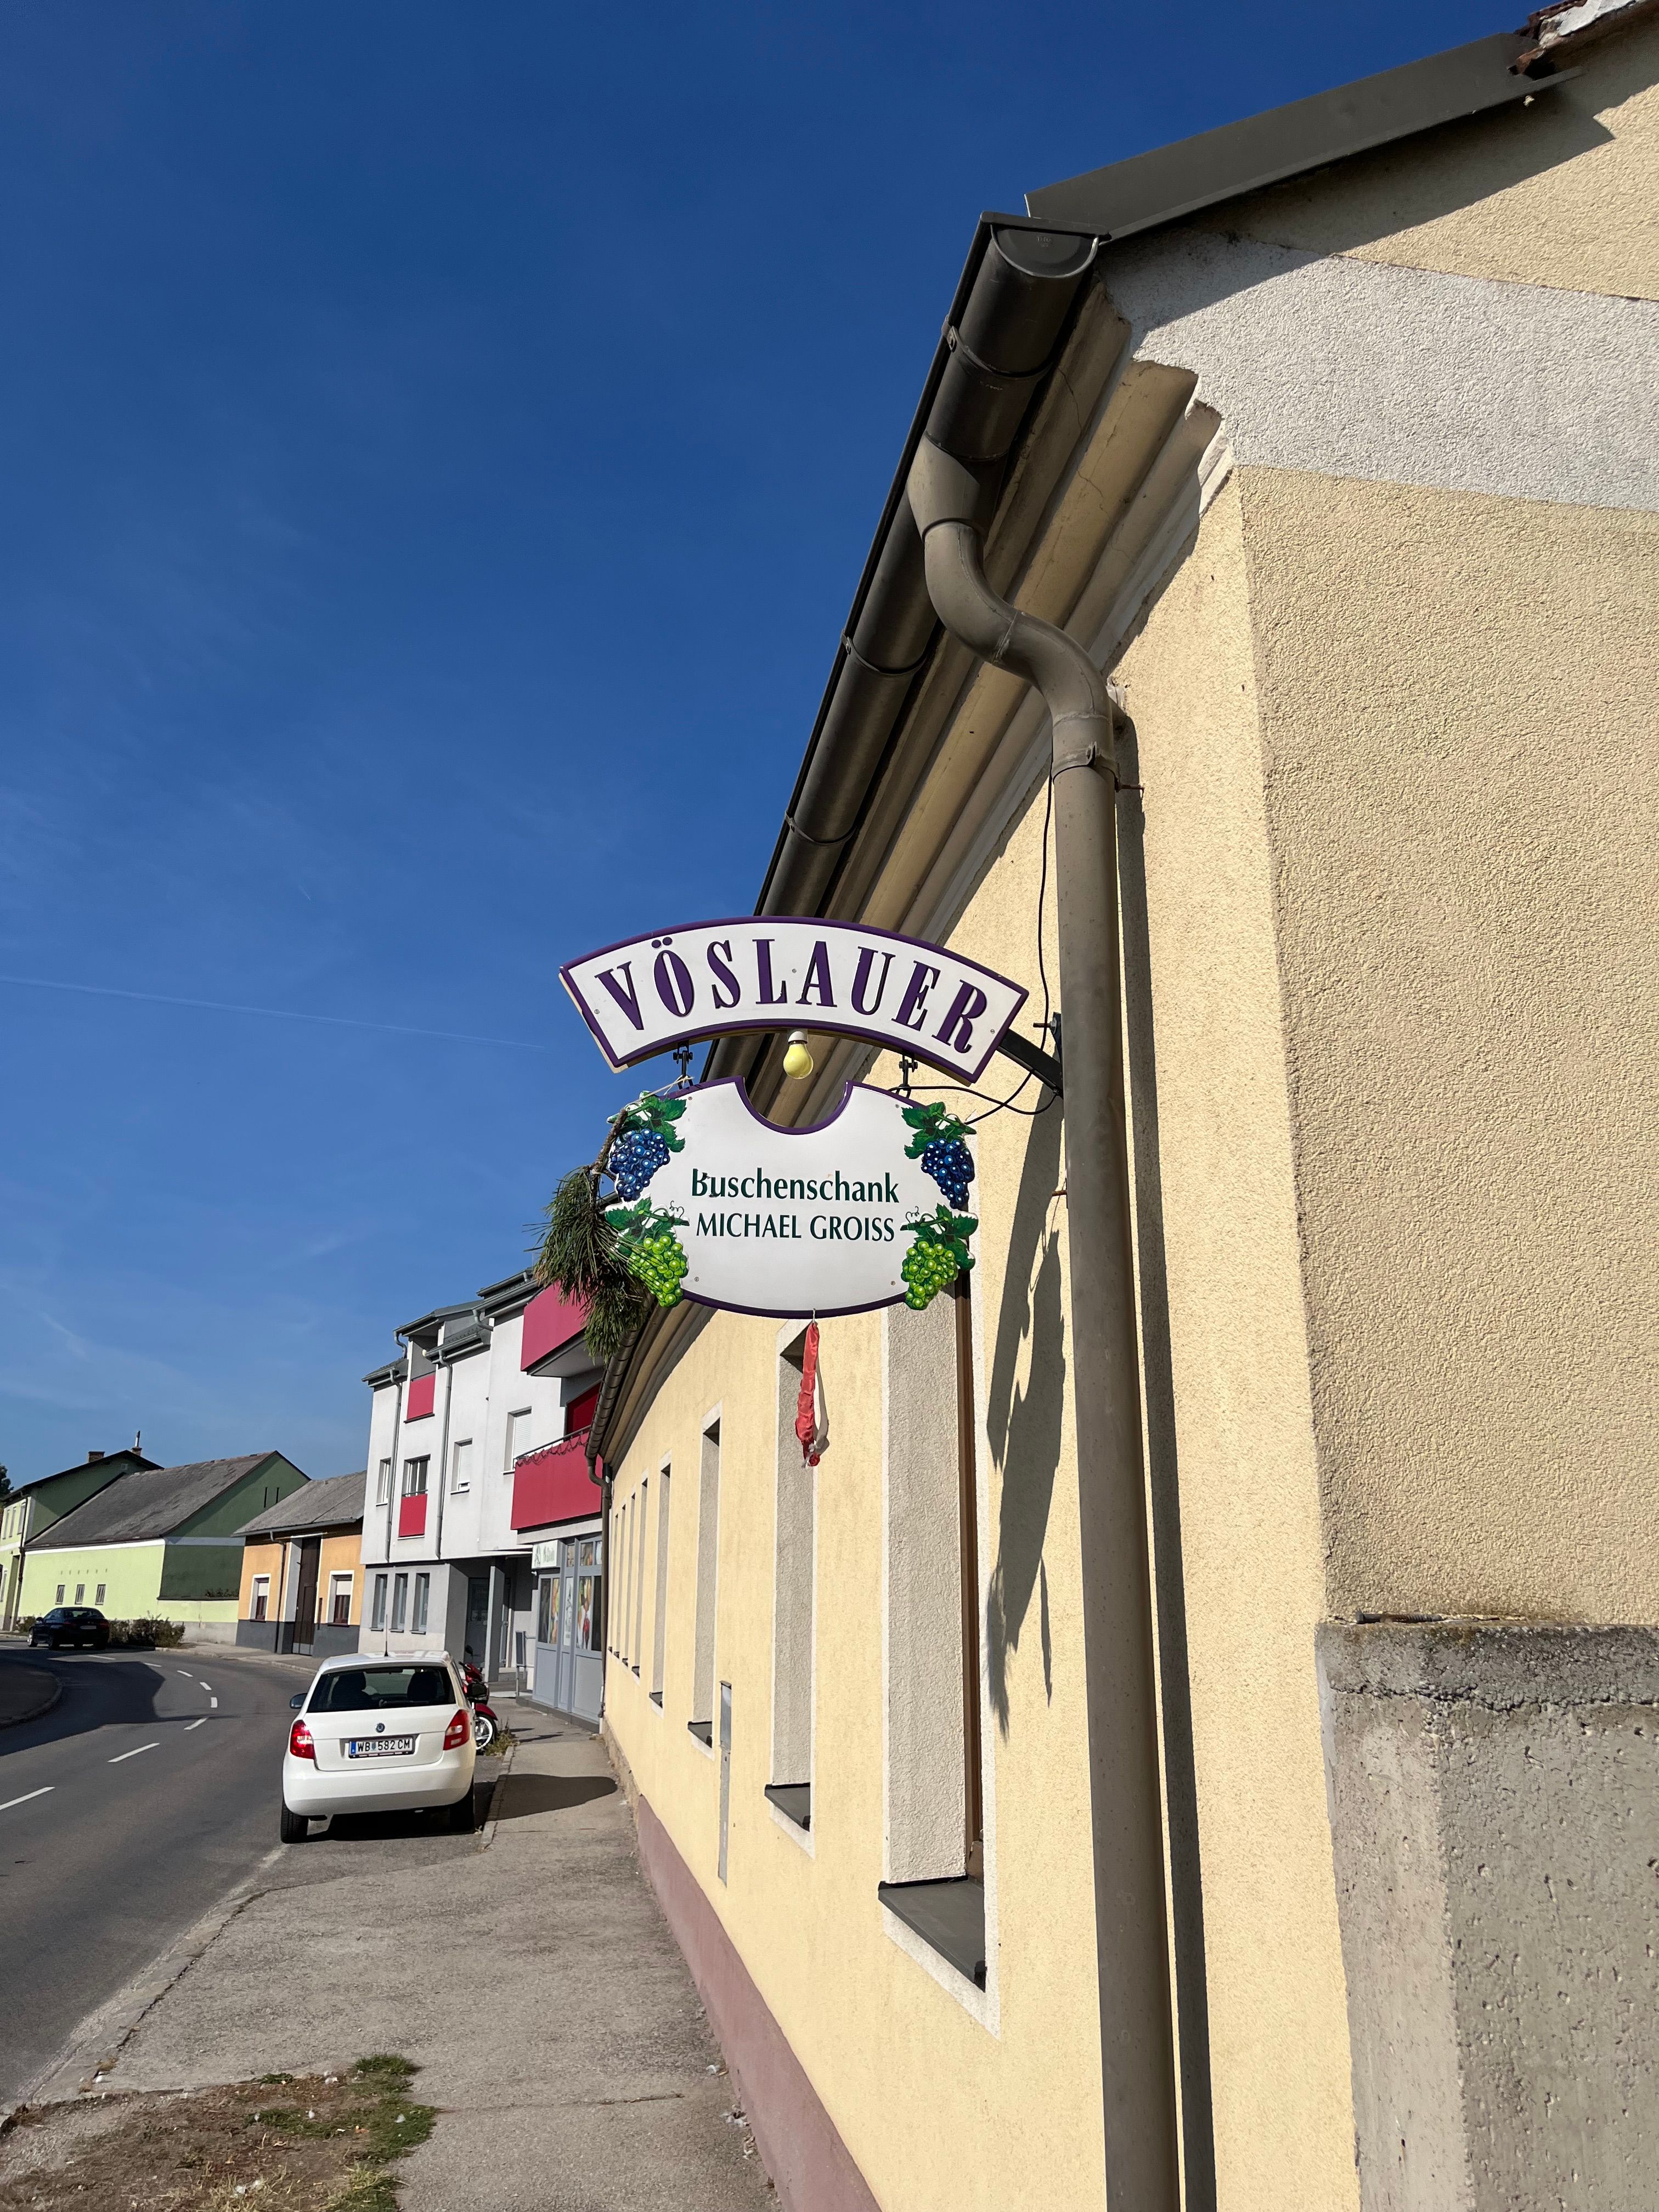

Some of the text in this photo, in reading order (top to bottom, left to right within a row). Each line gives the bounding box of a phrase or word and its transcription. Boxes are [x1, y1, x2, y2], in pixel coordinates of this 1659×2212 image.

[594, 936, 988, 1054] VÖSLAUER
[692, 1167, 900, 1203] Buschenschank
[696, 1212, 895, 1242] MICHAEL GROISS
[358, 1742, 370, 1752] WB
